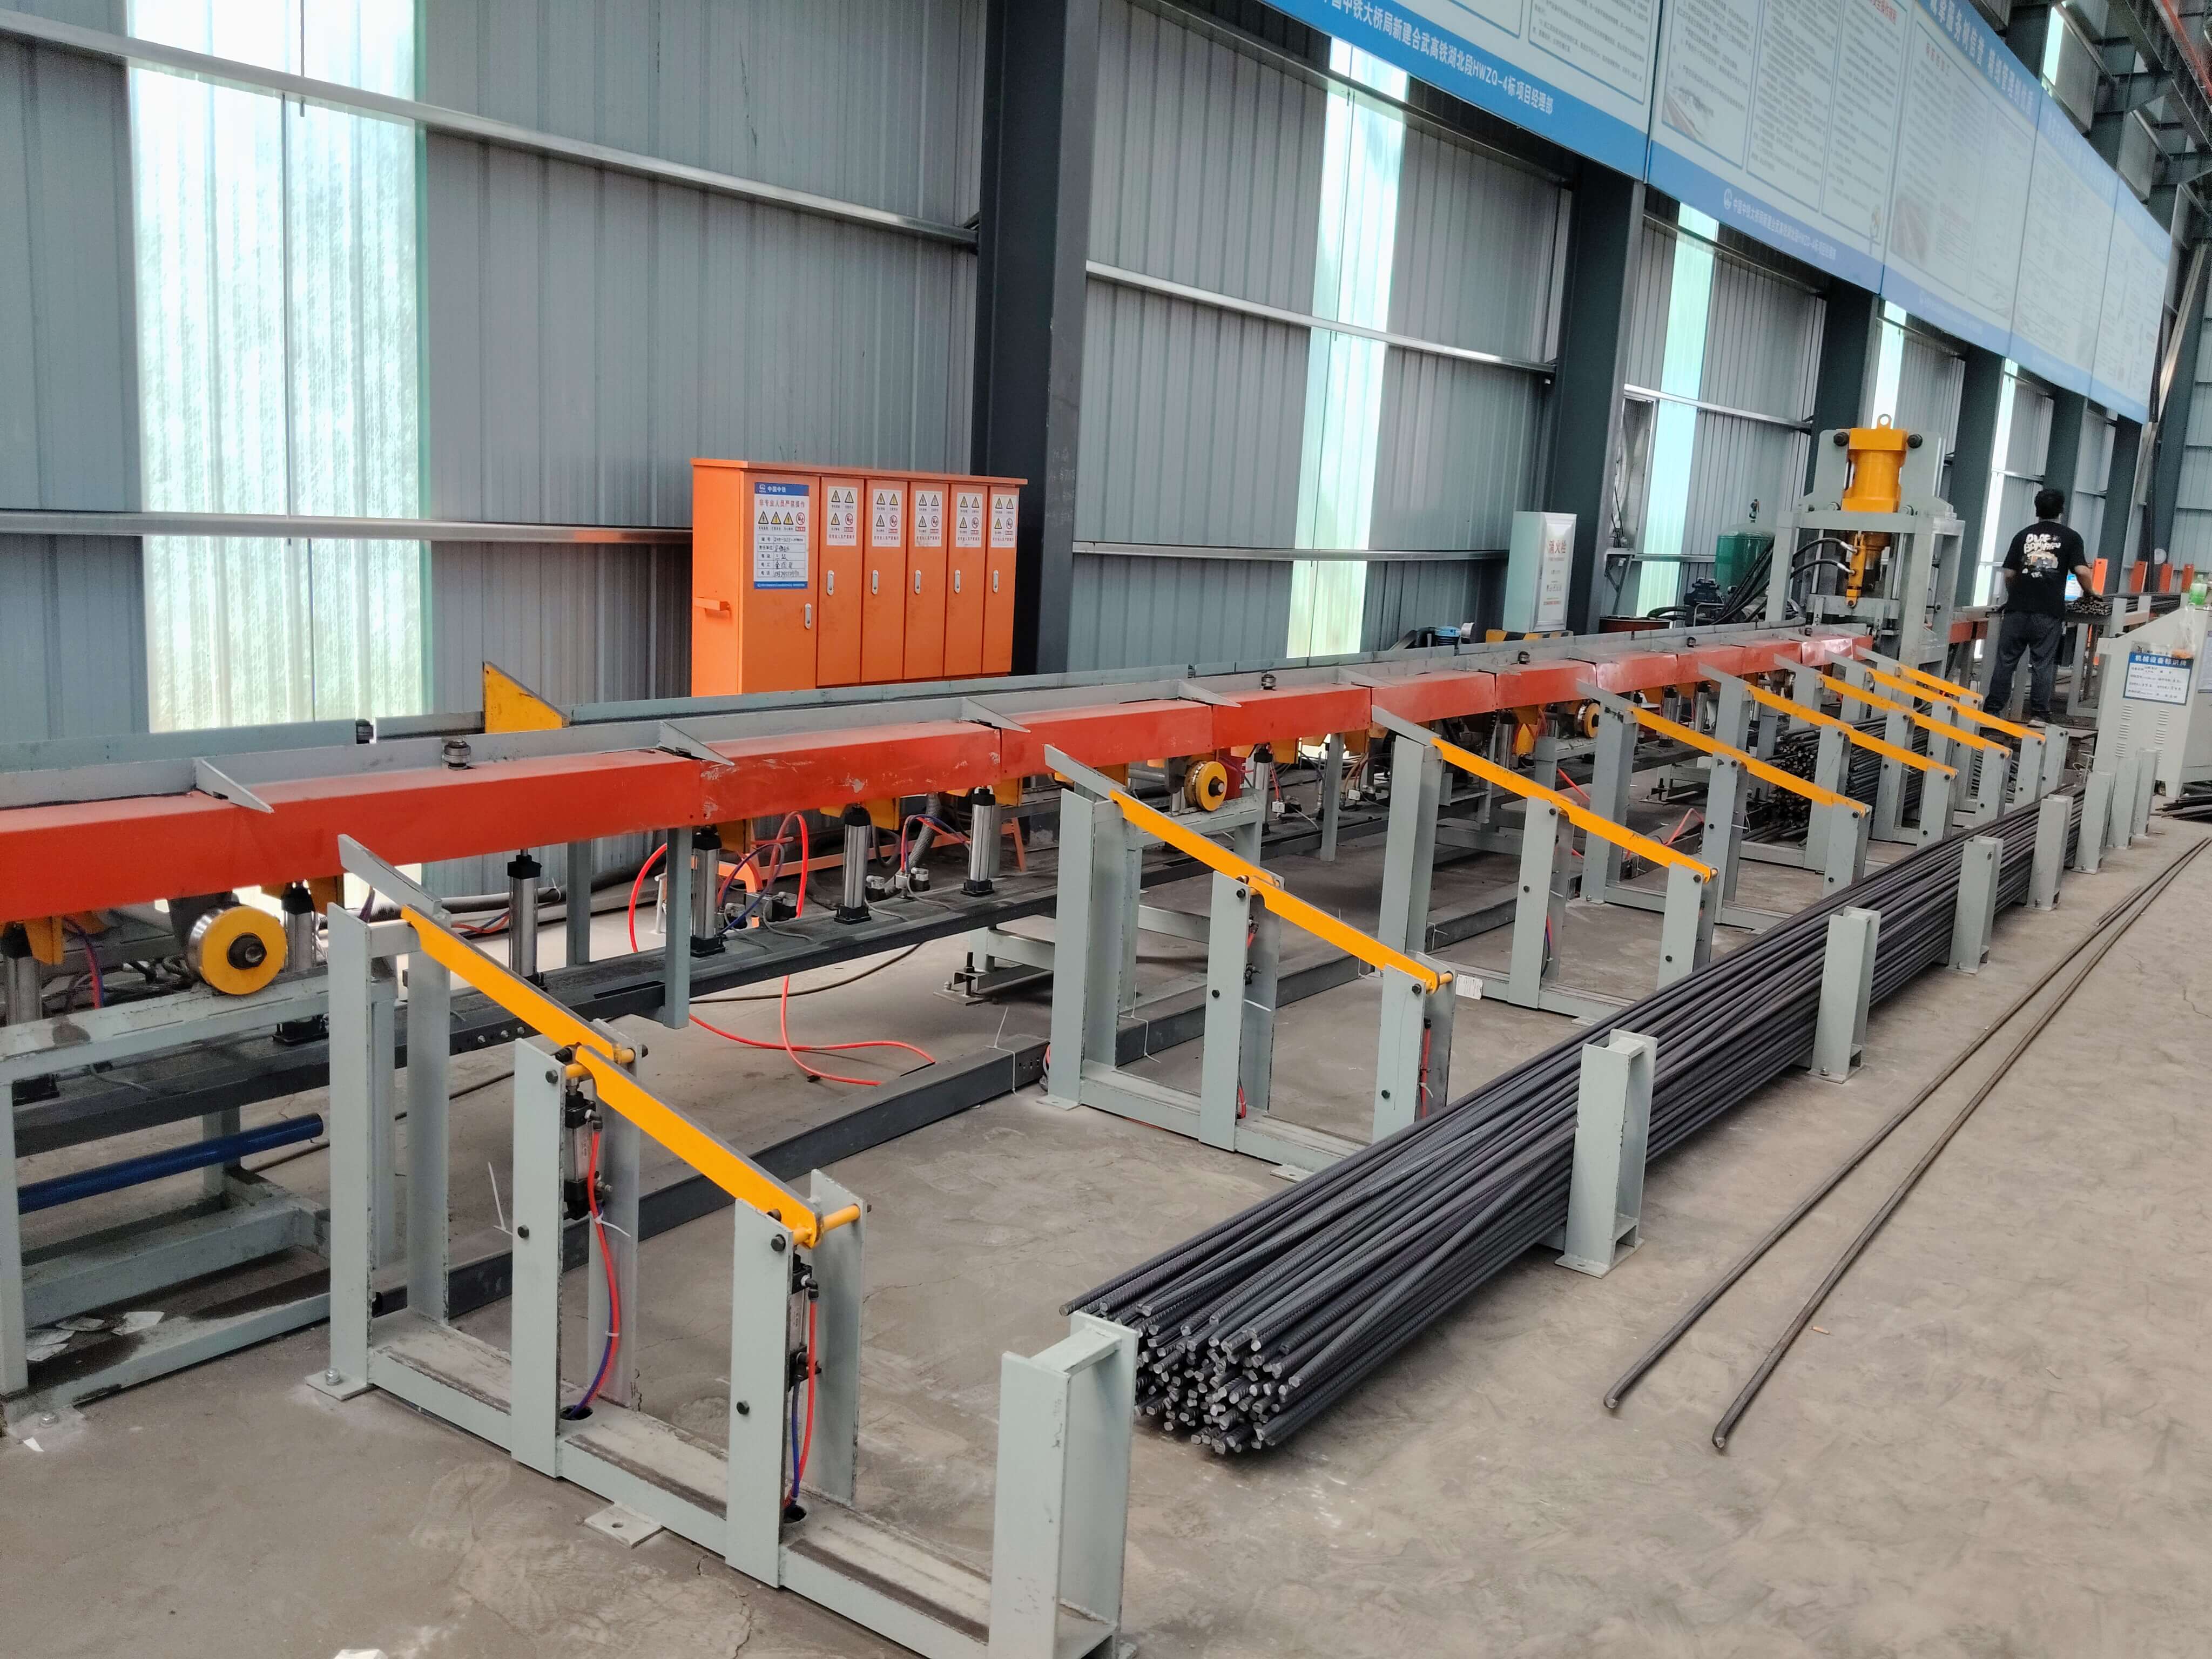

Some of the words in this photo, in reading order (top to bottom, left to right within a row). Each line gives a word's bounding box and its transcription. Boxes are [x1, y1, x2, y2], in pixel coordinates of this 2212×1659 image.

[1324, 0, 1553, 115] 中铁大桥局新建合武高铁湖北段HWZQ-4标项目经理部
[759, 499, 804, 508] 非专业人员严禁操作
